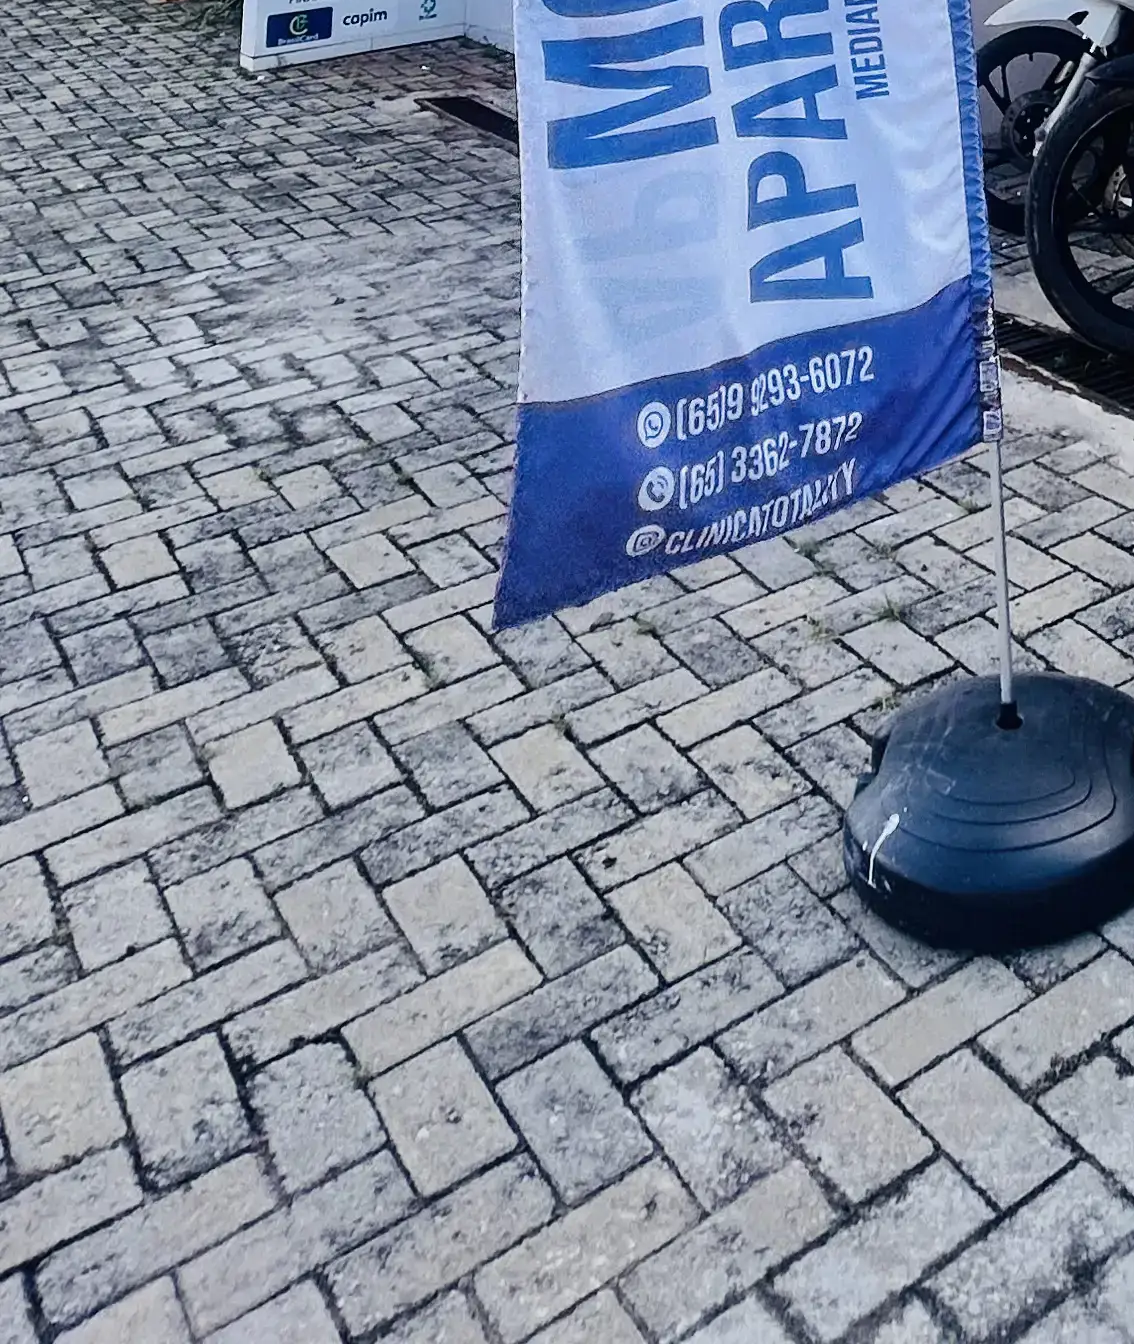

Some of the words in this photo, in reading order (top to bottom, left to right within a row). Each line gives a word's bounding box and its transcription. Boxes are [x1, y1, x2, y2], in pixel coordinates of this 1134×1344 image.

[342, 8, 388, 27] capim
[664, 457, 857, 555] CLINICATOTALITY
[679, 450, 724, 510] (65)
[731, 411, 863, 484] 3362-7872
